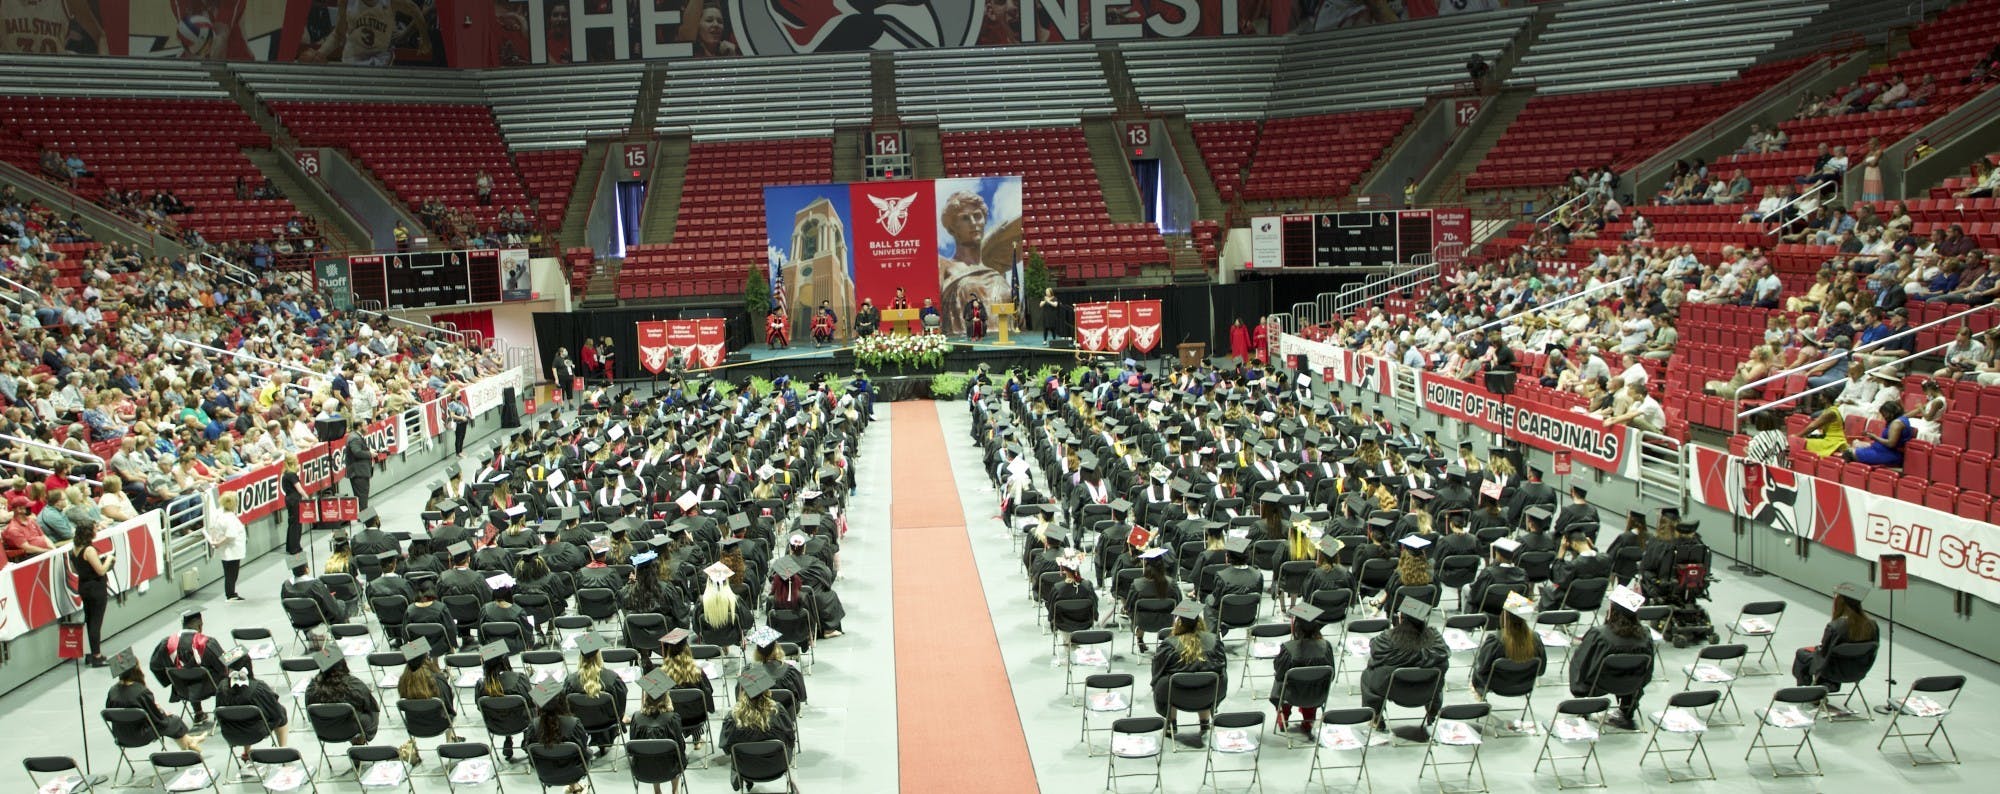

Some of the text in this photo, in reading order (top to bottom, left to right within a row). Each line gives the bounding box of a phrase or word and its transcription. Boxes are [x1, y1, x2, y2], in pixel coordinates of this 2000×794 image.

[508, 0, 694, 64] THE
[1128, 129, 1148, 144] 13
[877, 139, 897, 154] 14
[626, 151, 646, 166] 15
[1443, 232, 1458, 240] 70+
[869, 239, 920, 249] BALL STATE
[872, 248, 918, 256] UNIVERSITY
[1426, 381, 1619, 462] HOME OF THE CARDINALS
[303, 453, 331, 486] THE
[1866, 513, 1932, 558] Ball
